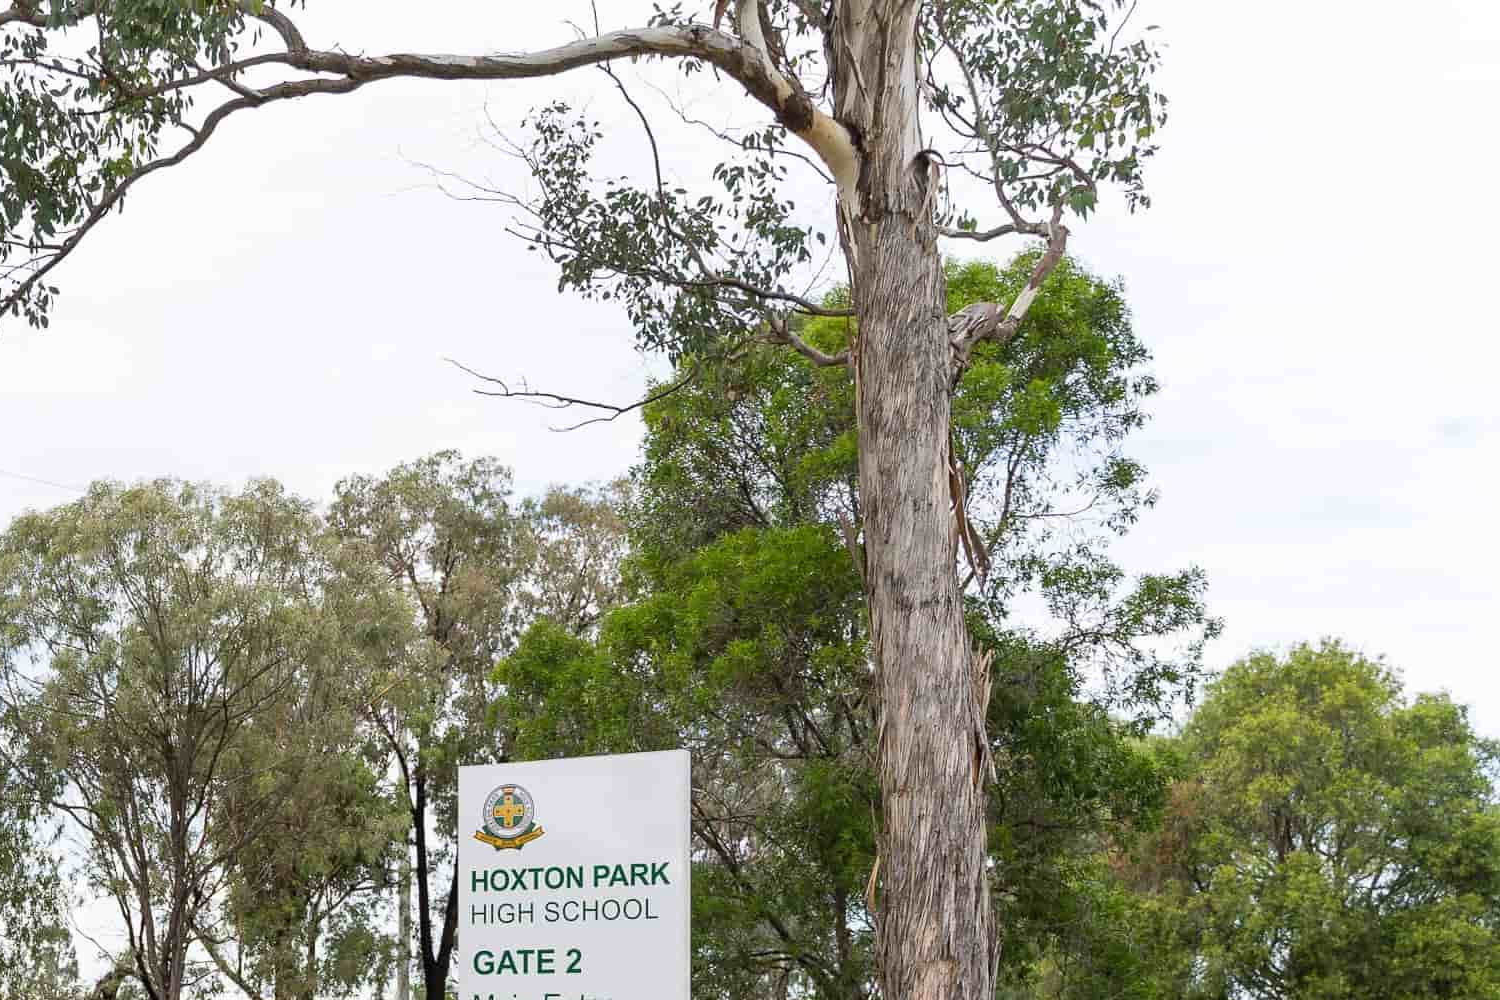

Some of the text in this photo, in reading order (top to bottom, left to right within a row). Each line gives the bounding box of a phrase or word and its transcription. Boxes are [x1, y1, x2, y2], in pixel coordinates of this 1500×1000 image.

[471, 862, 671, 892] HOXTON PARK
[471, 898, 659, 925] HIGH SCHOOL
[473, 948, 582, 975] GATE 2
